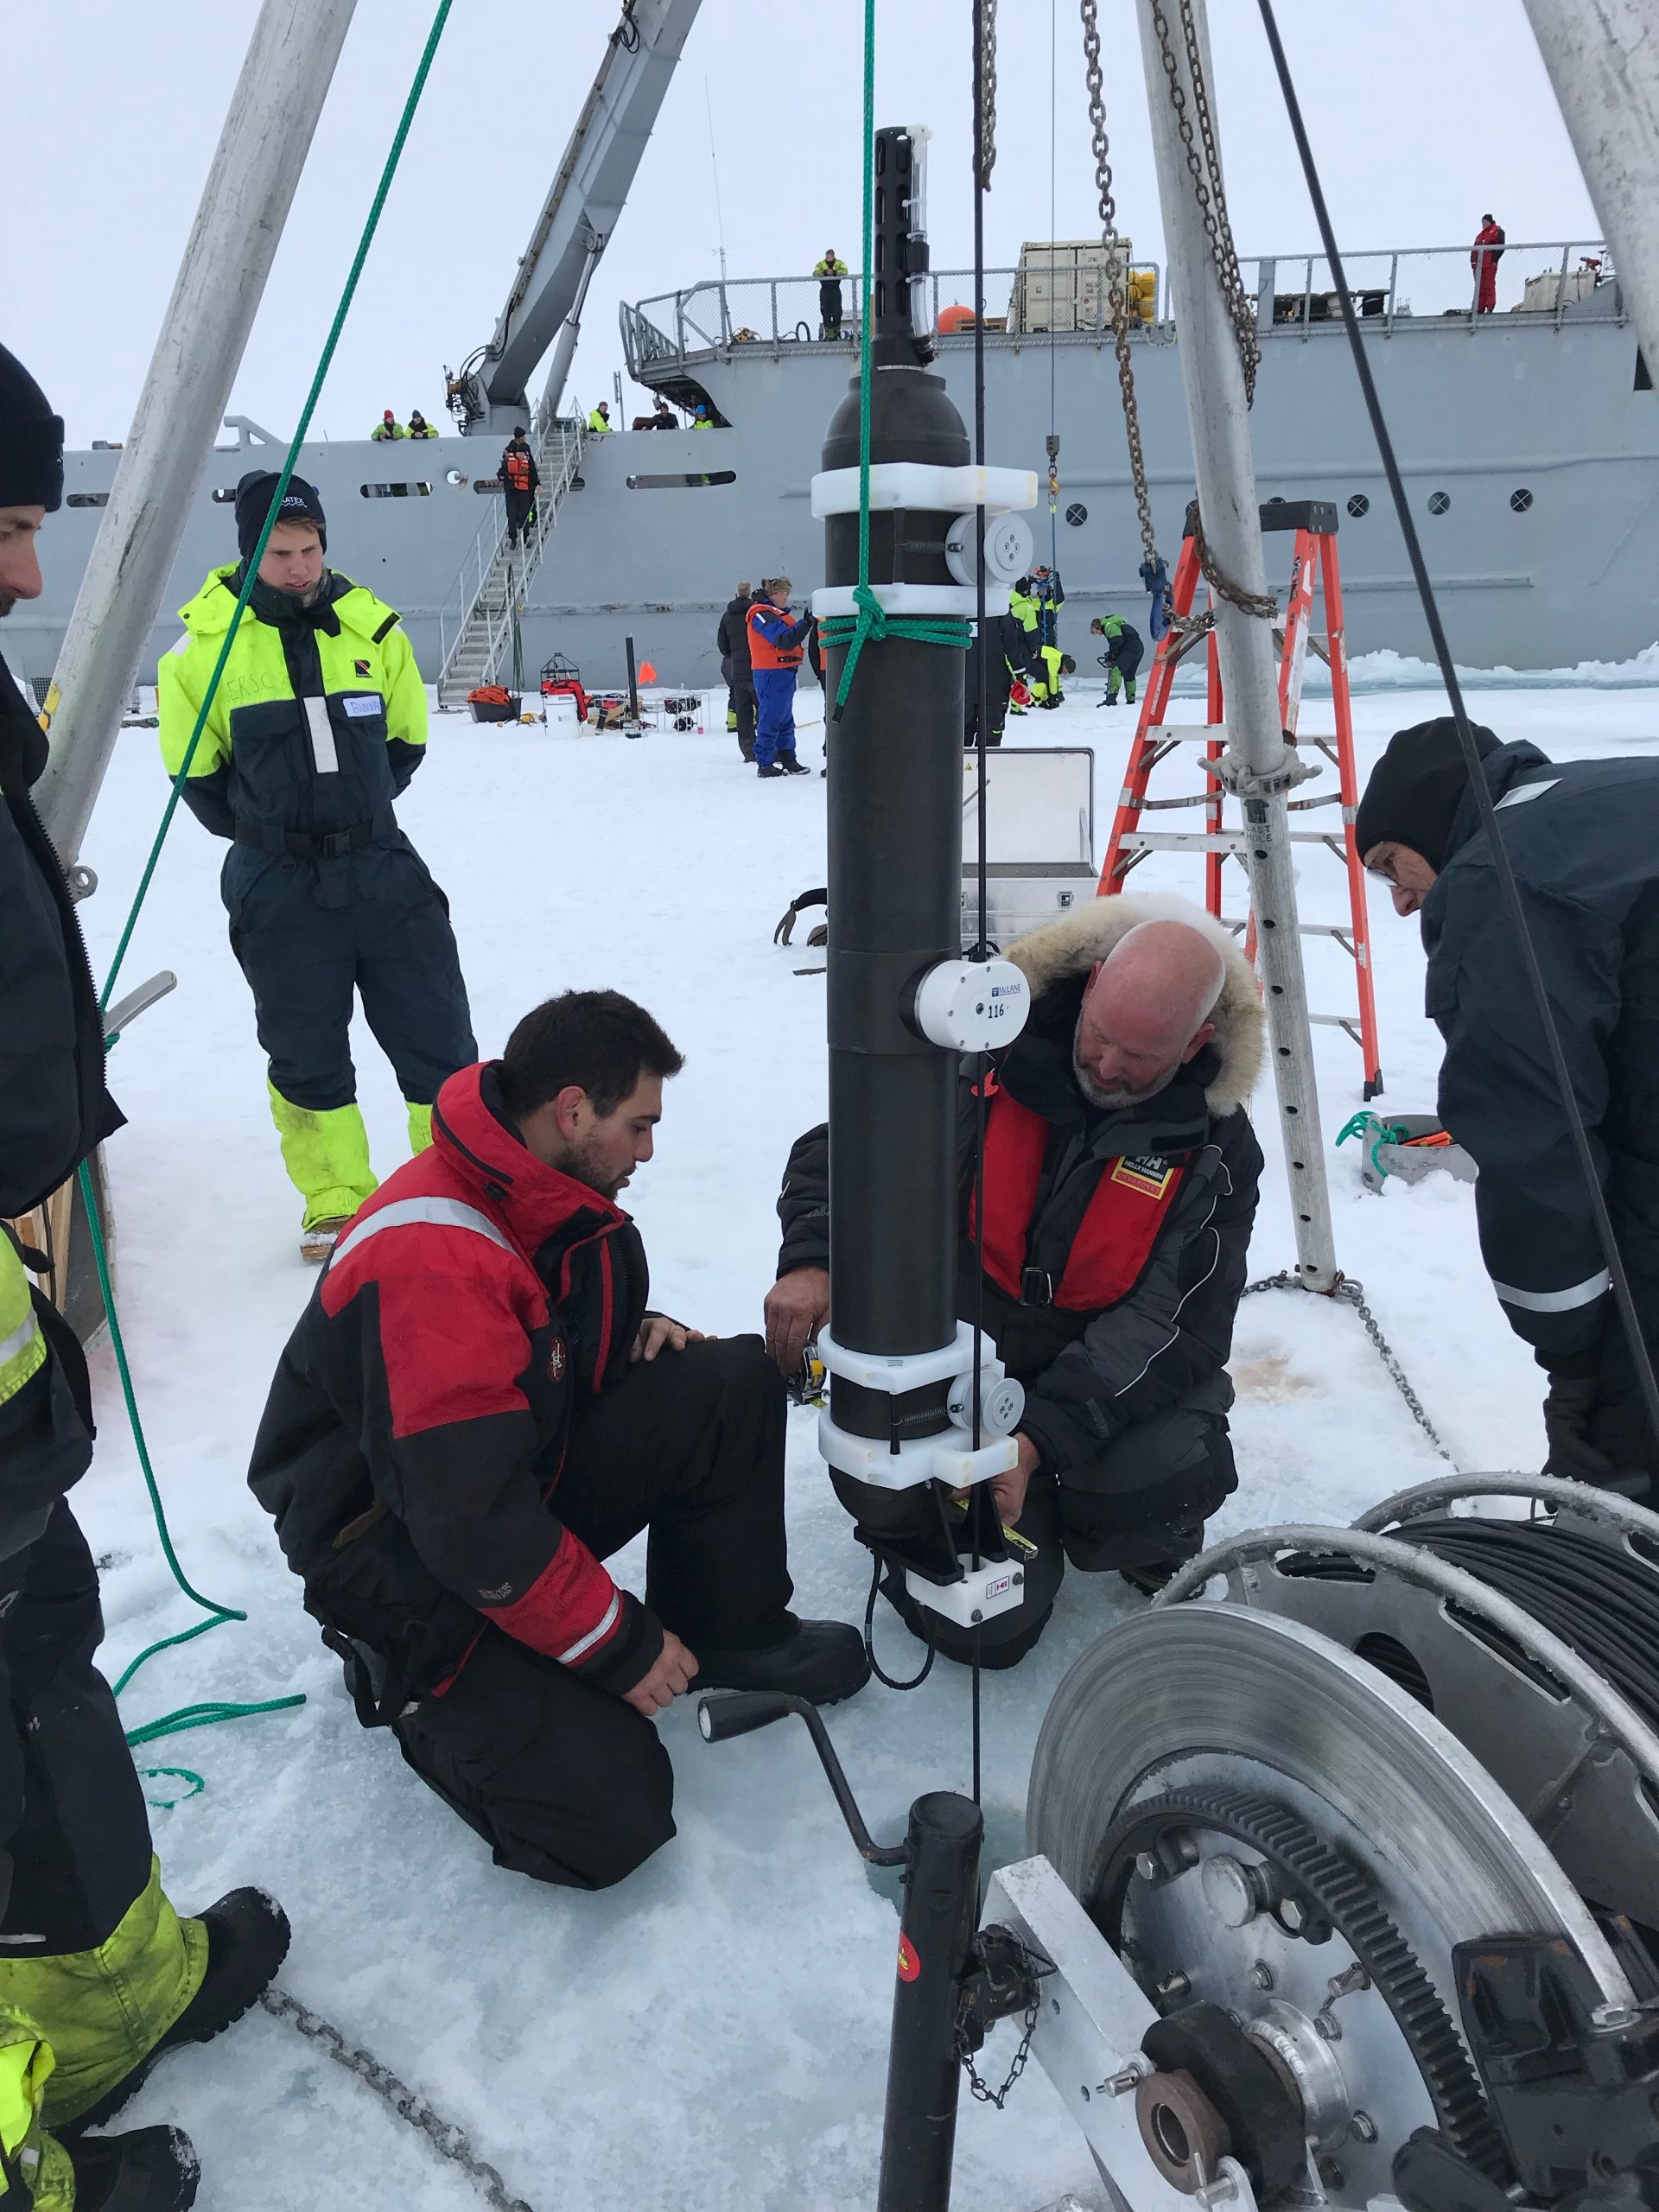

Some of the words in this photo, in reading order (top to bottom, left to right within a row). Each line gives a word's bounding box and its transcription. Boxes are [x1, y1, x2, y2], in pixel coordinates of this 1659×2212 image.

[999, 983, 1021, 994] McLANE
[988, 1003, 1005, 1019] 116
[1124, 1160, 1141, 1171] HELLY
[1141, 1166, 1164, 1180] HANSEN
